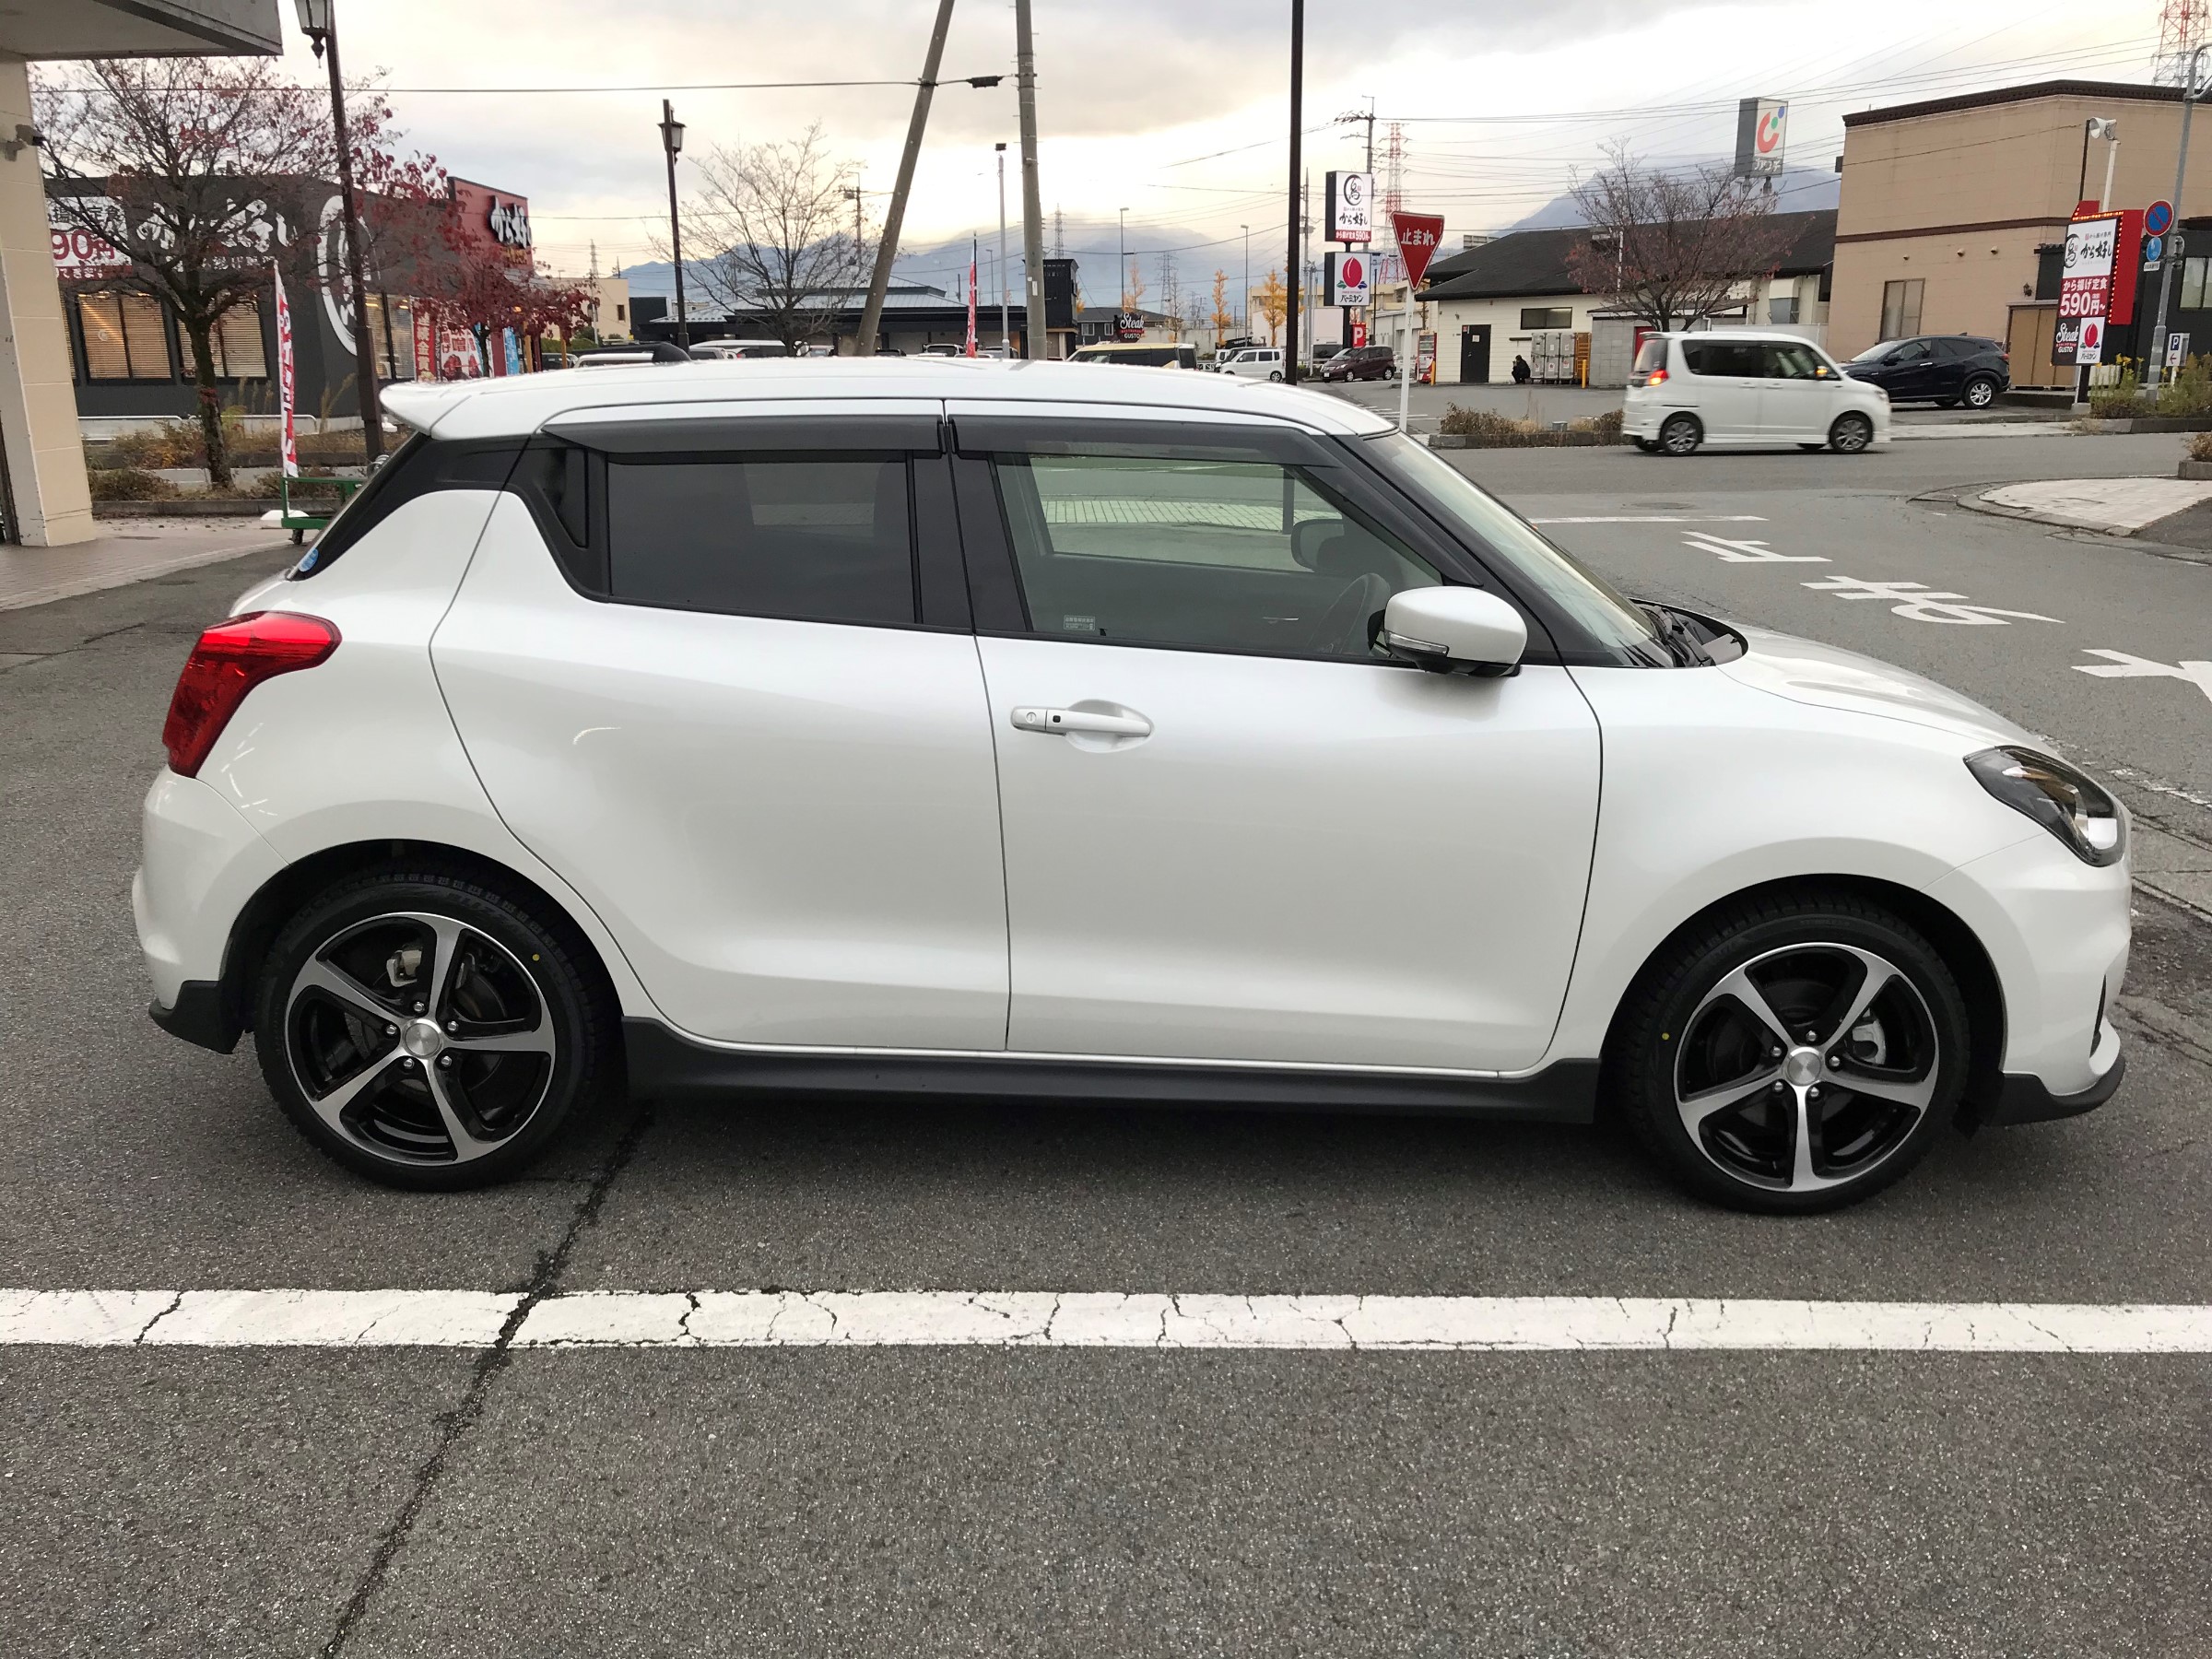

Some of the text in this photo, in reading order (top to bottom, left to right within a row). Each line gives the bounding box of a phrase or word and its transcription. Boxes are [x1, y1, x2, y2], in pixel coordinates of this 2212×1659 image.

[1401, 227, 1435, 246] 止まれ
[2063, 277, 2108, 291] から揚げ定食
[1120, 312, 1144, 329] Steak
[1354, 327, 1364, 344] P
[2055, 323, 2078, 343] Steak
[2172, 337, 2179, 348] P
